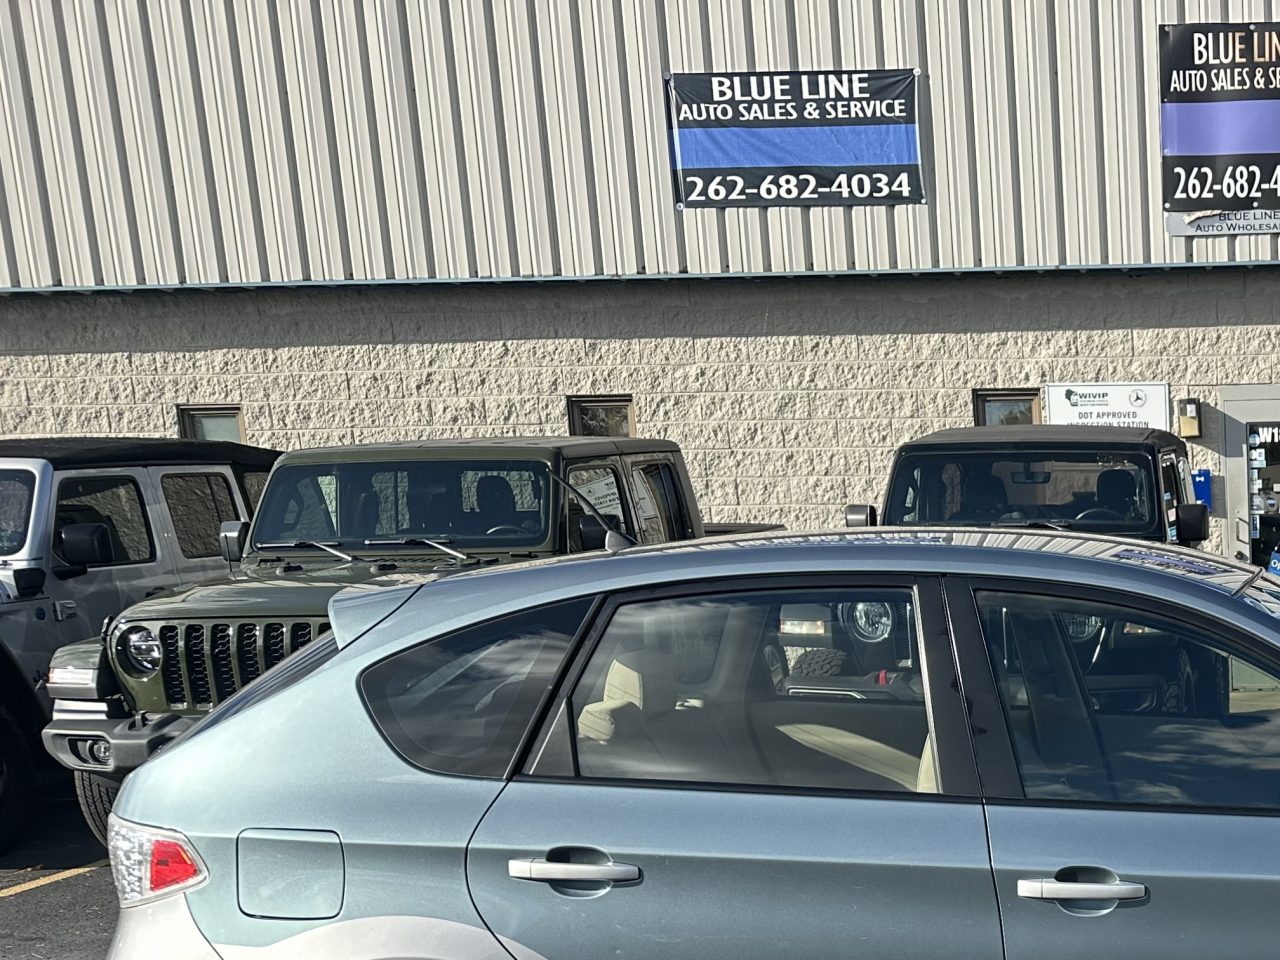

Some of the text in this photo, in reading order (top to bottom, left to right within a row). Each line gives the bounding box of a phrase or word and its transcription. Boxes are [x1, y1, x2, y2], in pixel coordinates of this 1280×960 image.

[1193, 32, 1246, 65] BLUE
[711, 73, 870, 101] BLUE LINE
[1170, 69, 1207, 92] AUTO
[1211, 67, 1250, 91] SALES
[1254, 67, 1265, 89] &
[679, 99, 906, 121] AUTO SALES & SERVICE
[686, 173, 911, 201] 262-682-4034
[1219, 211, 1280, 222] BLUE LINE
[1195, 224, 1223, 233] AUTO
[1078, 411, 1138, 419] DOT APPROVED
